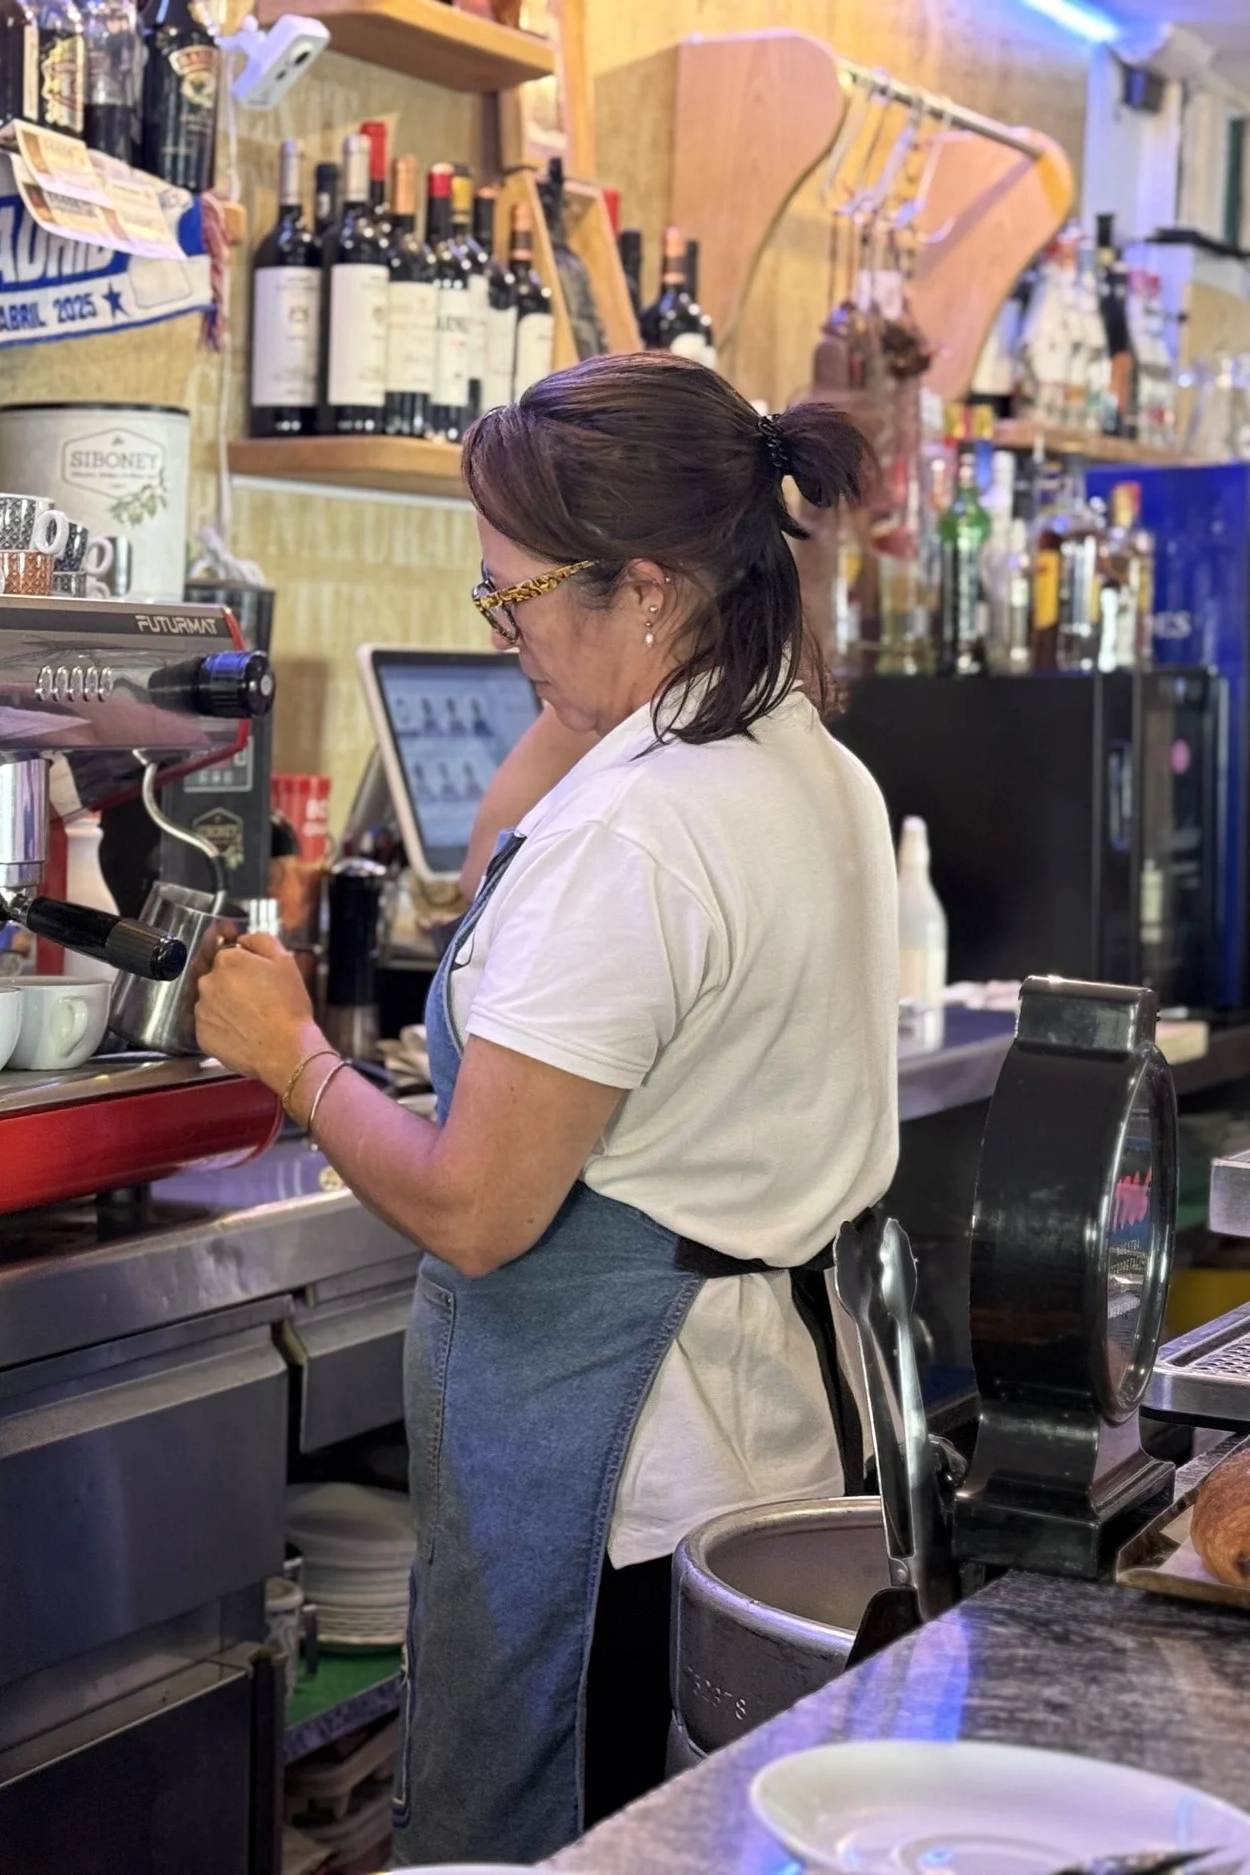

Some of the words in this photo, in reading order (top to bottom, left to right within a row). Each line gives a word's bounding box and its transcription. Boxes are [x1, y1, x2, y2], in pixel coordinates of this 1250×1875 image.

[52, 293, 98, 324] 2025
[70, 450, 158, 471] SIBONEY
[135, 614, 218, 635] FUTURMAT
